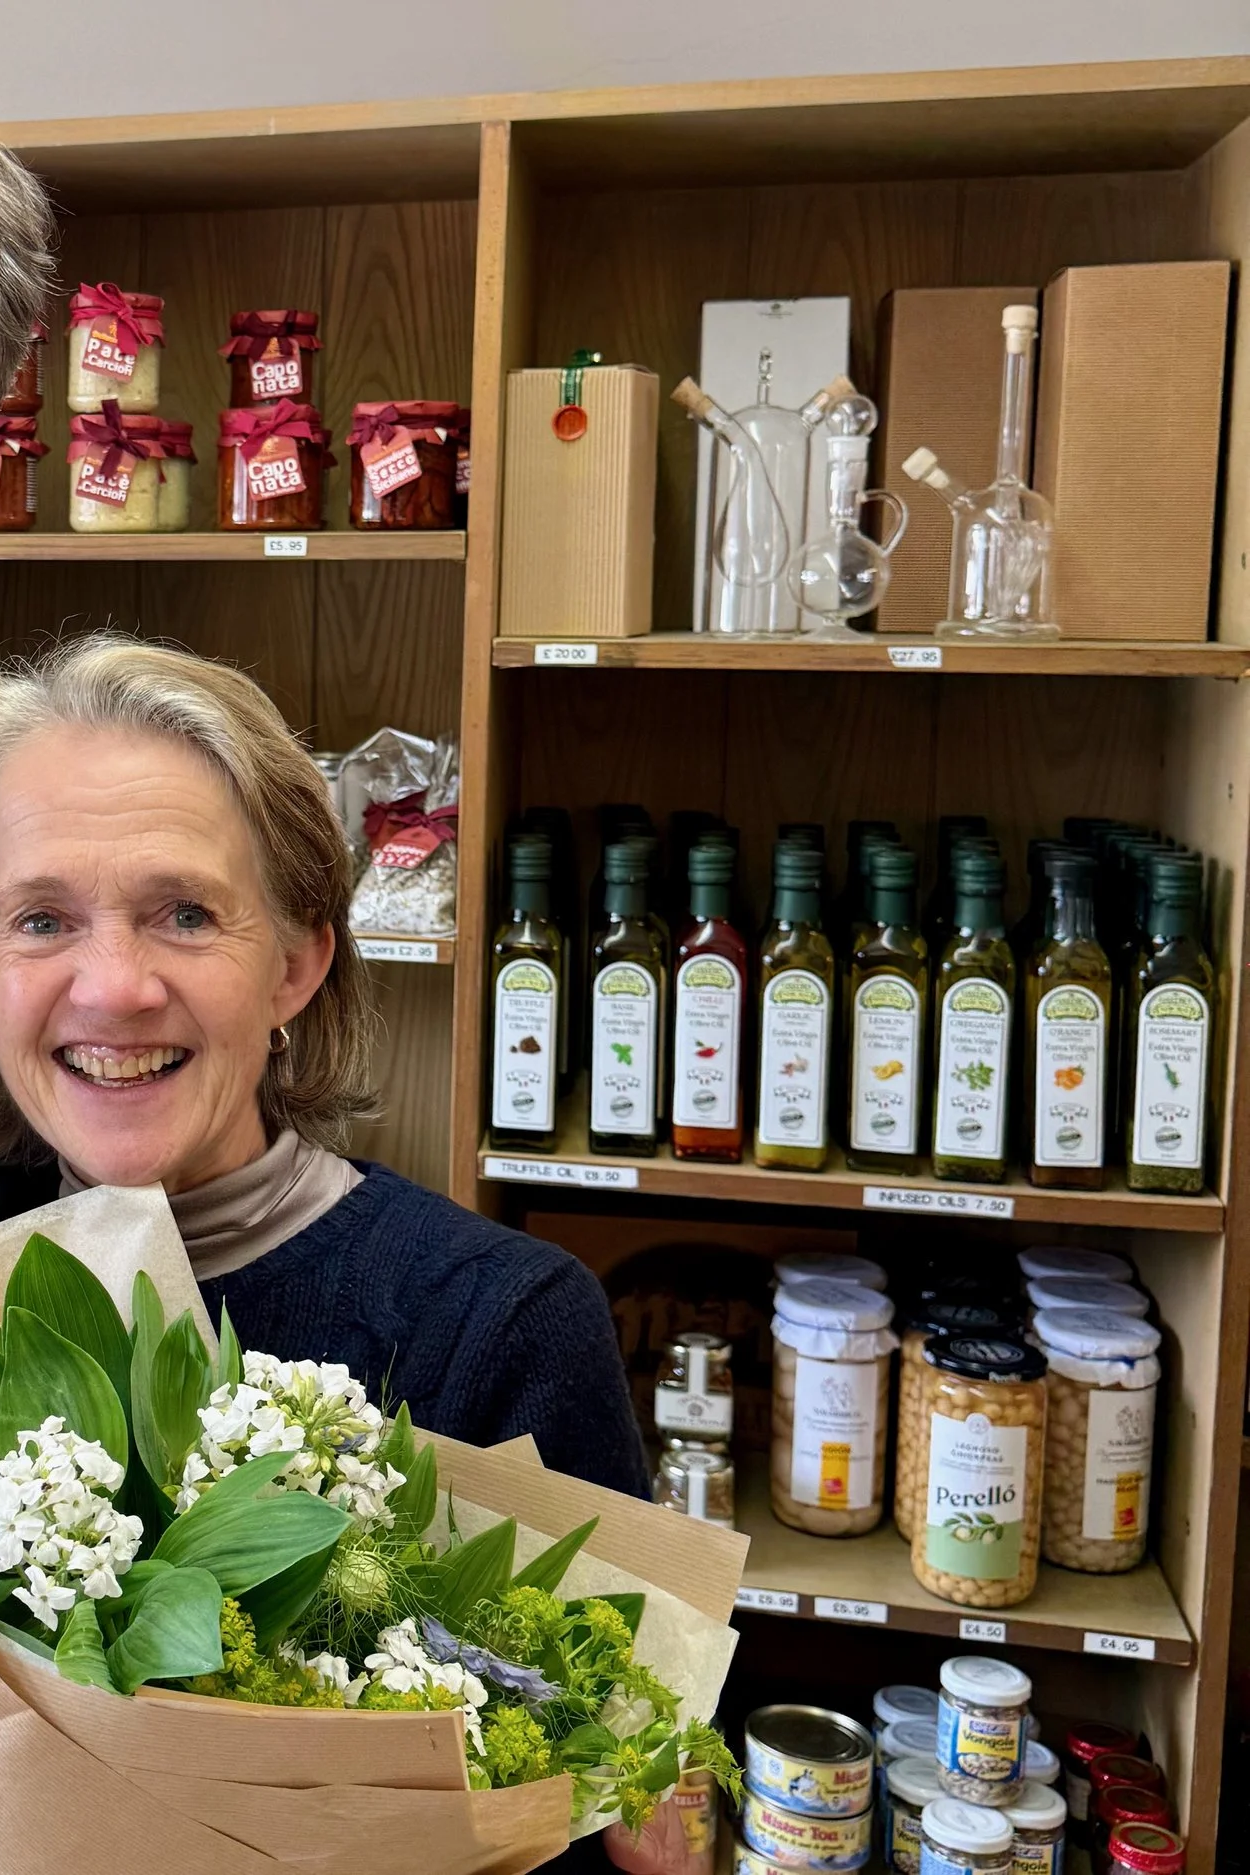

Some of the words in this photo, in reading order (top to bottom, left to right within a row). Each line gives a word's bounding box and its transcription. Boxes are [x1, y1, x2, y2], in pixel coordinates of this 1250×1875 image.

[252, 361, 298, 380] Capo
[253, 375, 300, 393] nata
[248, 457, 298, 480] Capo
[251, 472, 301, 494] nata
[270, 541, 303, 552] £5.95
[891, 651, 938, 662] £27.95
[868, 1016, 906, 1025] LEMON
[501, 1162, 551, 1177] TRUFFLE
[556, 1166, 575, 1178] OIL
[879, 1191, 932, 1205] INFUSED
[937, 1195, 967, 1208] OILS
[975, 1199, 1007, 1212] 7.50
[936, 1484, 1016, 1507] Perelló
[965, 1623, 1002, 1637] £4.50
[1100, 1637, 1140, 1653] £4.95
[963, 1730, 1015, 1749] Vongole
[761, 1811, 806, 1838] Mister
[1011, 1859, 1050, 1872] ngole
